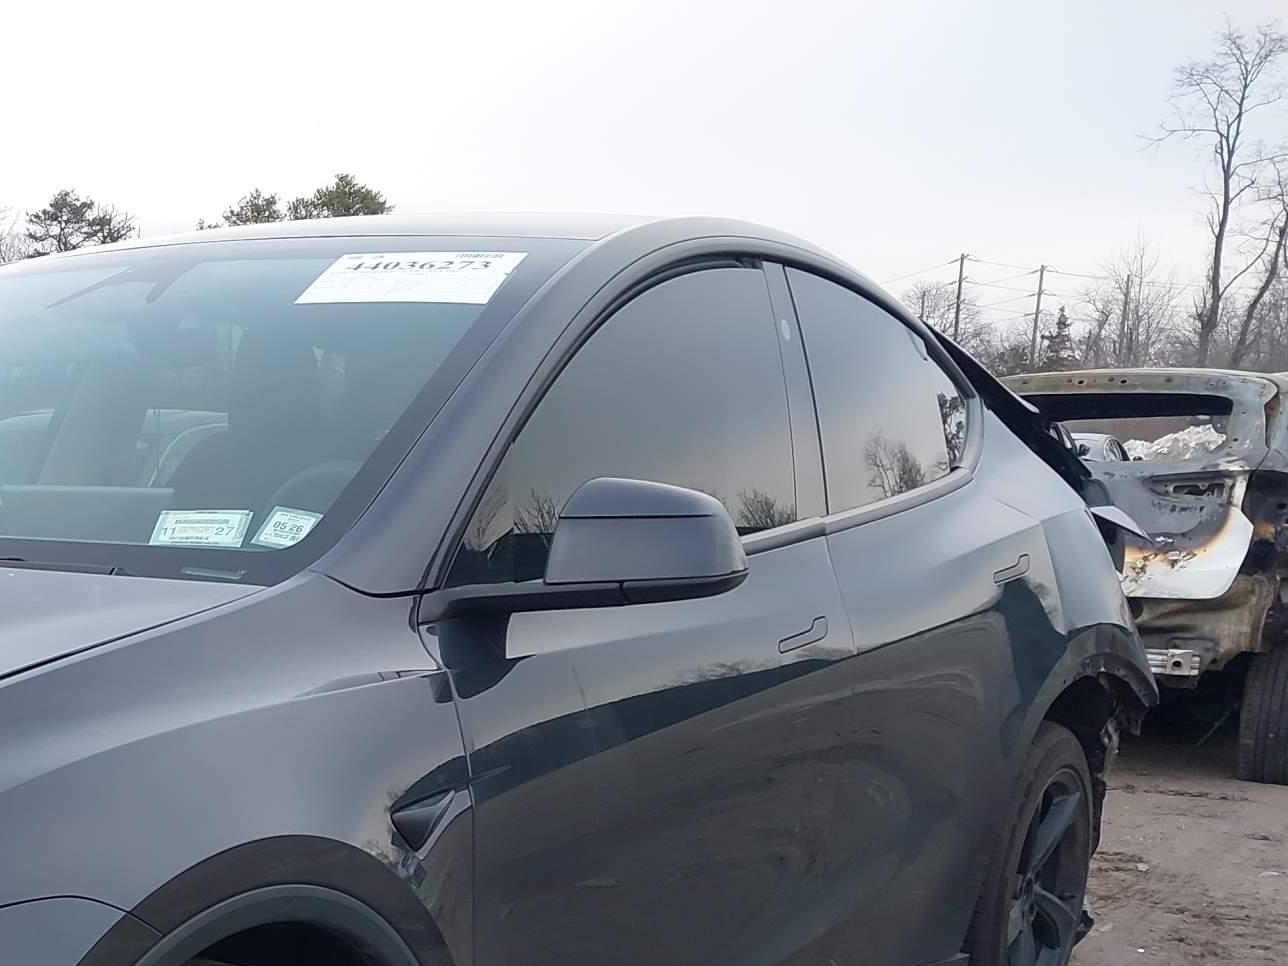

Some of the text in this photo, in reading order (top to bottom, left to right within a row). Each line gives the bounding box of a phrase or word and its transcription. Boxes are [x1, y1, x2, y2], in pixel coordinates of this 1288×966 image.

[346, 260, 493, 272] 44036273
[161, 526, 235, 536] 11 27
